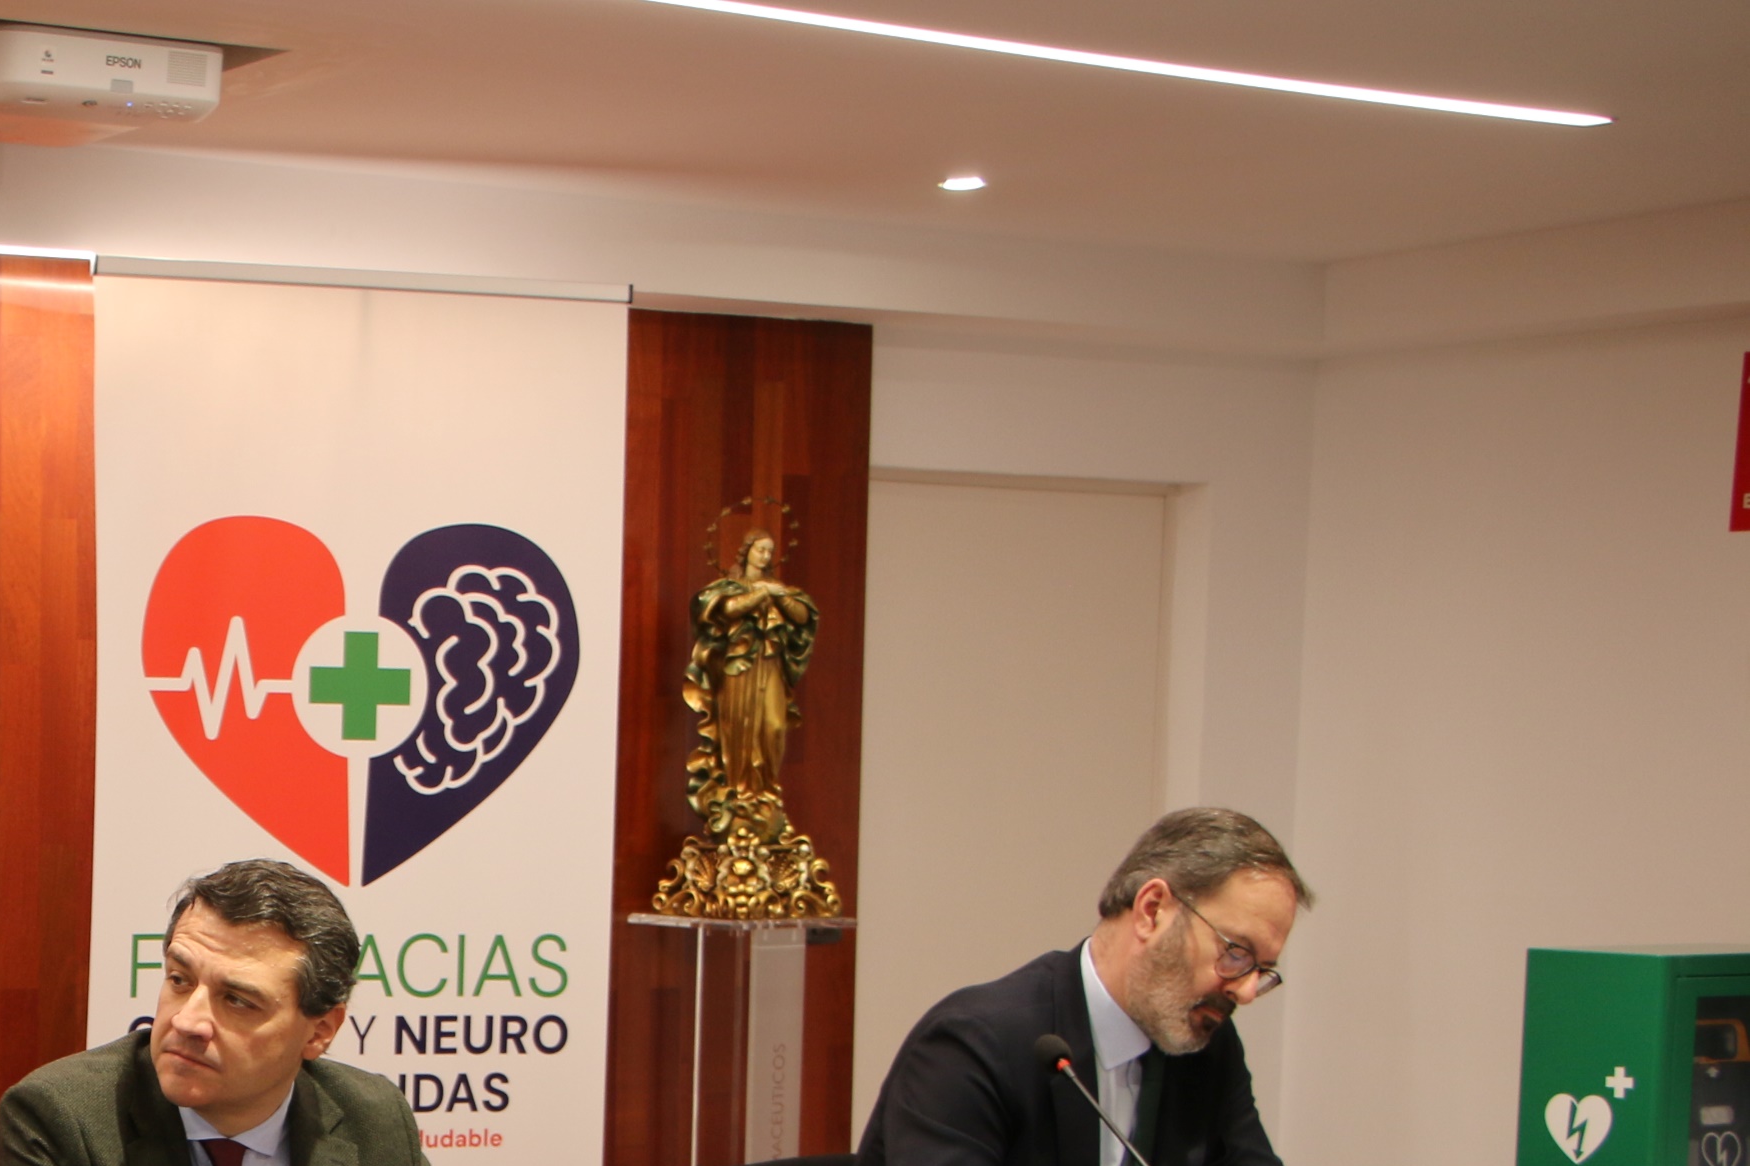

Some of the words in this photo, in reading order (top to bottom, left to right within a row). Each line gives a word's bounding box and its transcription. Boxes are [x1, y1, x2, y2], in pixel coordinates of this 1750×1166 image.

[105, 55, 142, 69] EPSON
[130, 932, 569, 999] FACIAS
[350, 1016, 377, 1056] Y
[394, 1014, 569, 1056] NEURO
[418, 1128, 503, 1149] ludable
